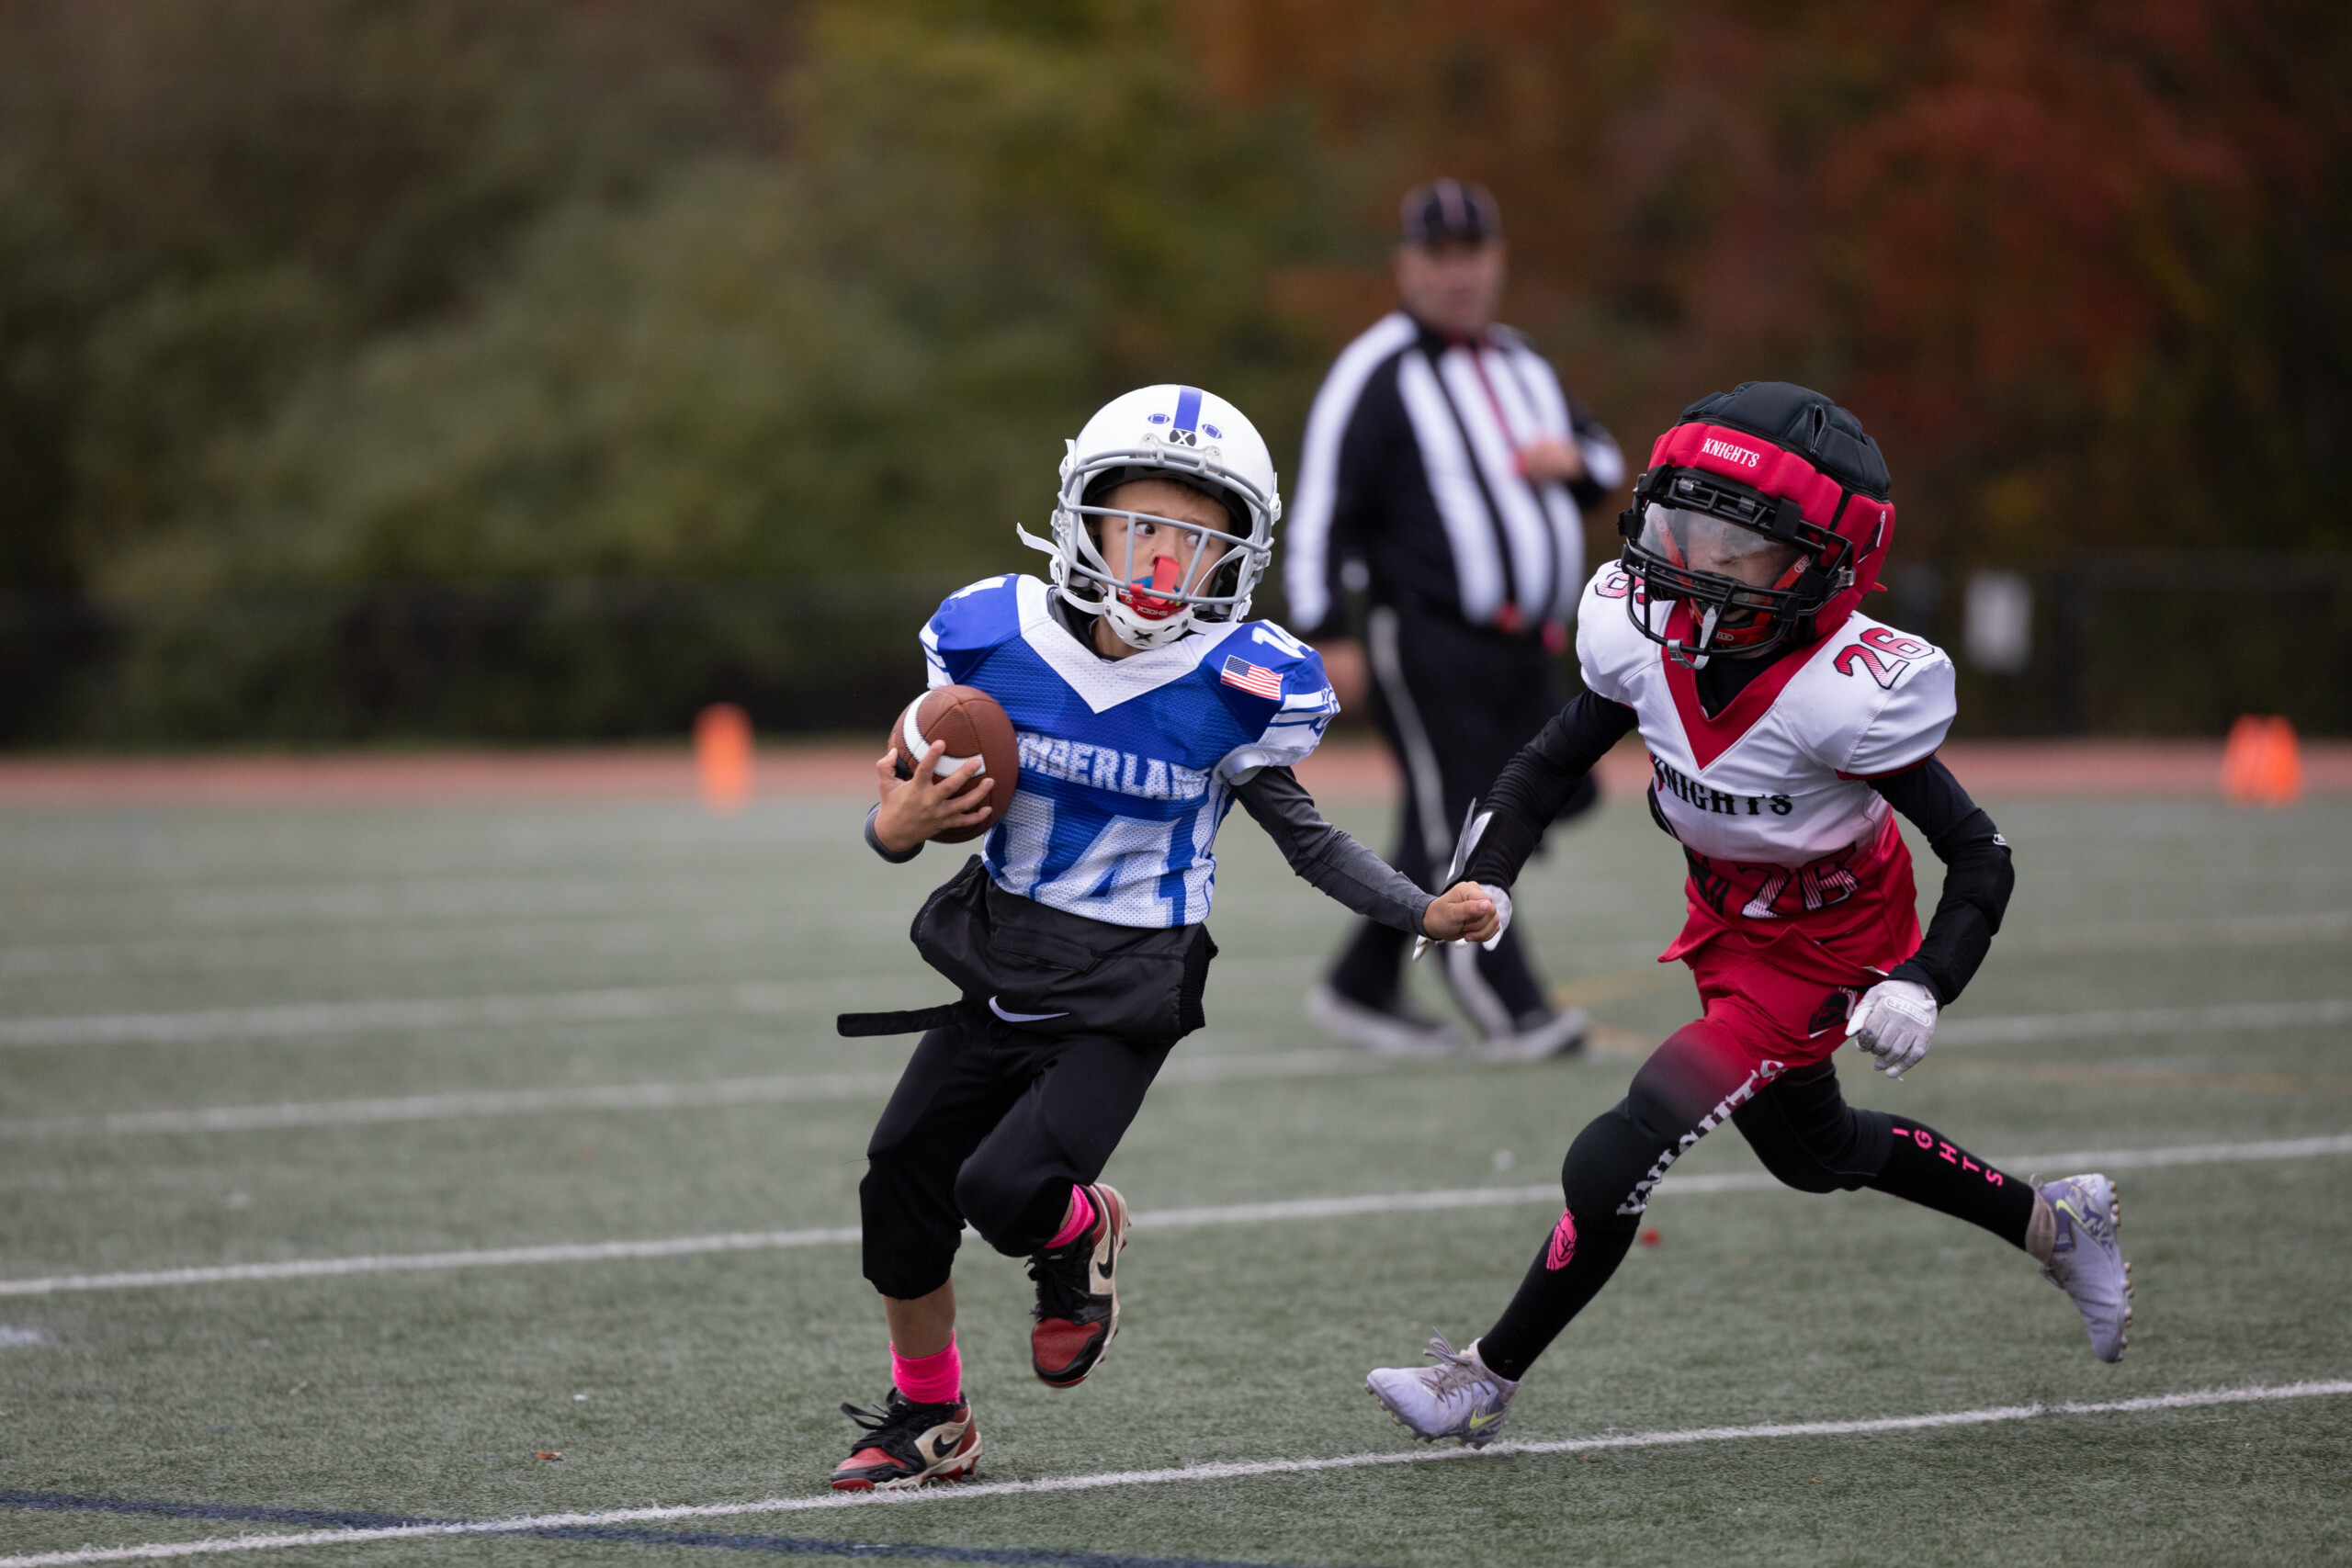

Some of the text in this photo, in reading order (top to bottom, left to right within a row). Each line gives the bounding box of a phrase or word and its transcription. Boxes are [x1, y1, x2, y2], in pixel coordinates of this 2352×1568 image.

[1702, 438, 1760, 468] KNIGHTS
[1833, 627, 1935, 690] 26
[1016, 732, 1210, 801] MBERLAN
[1650, 752, 1793, 816] KNIGHTS
[999, 788, 1182, 928] 14
[1893, 1127, 2003, 1187] IGHTS
